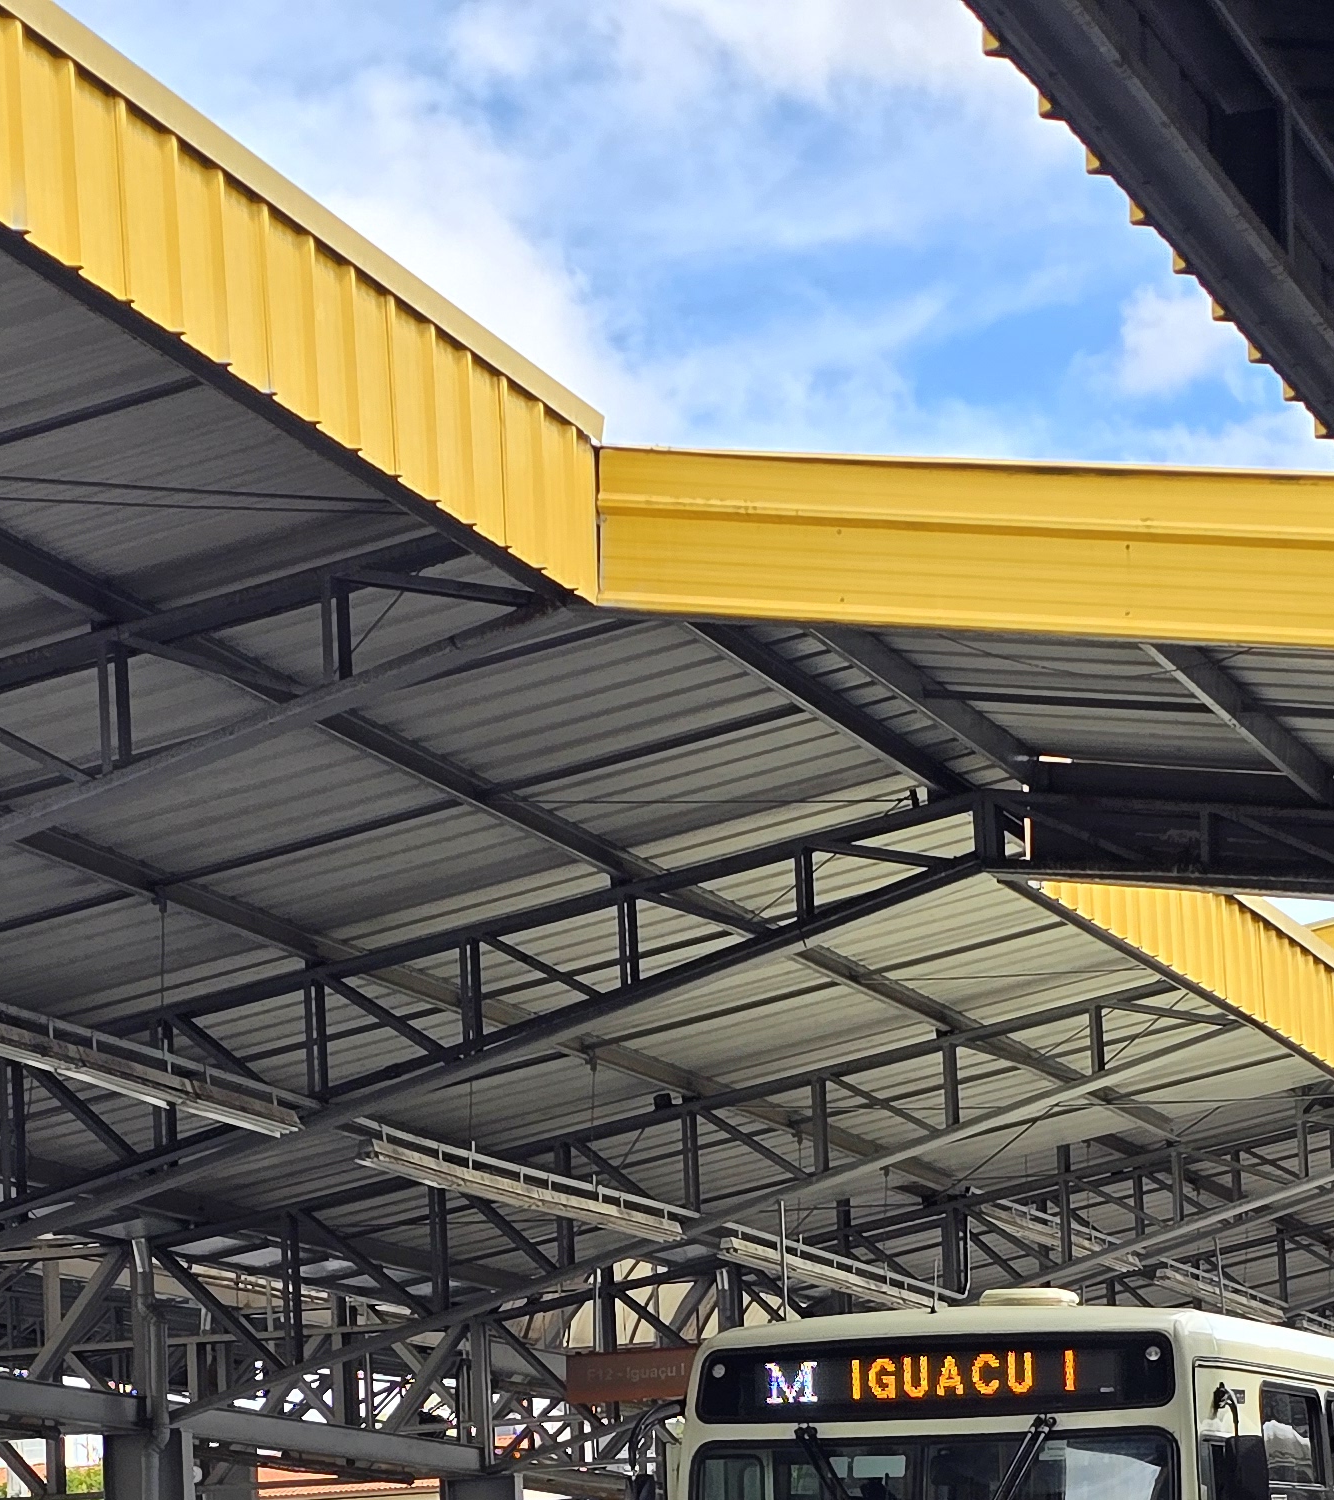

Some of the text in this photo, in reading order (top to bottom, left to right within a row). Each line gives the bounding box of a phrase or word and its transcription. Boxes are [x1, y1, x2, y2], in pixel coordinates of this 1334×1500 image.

[626, 1366, 676, 1382] Iguaçu
[765, 1350, 1076, 1404] M IGUACU I
